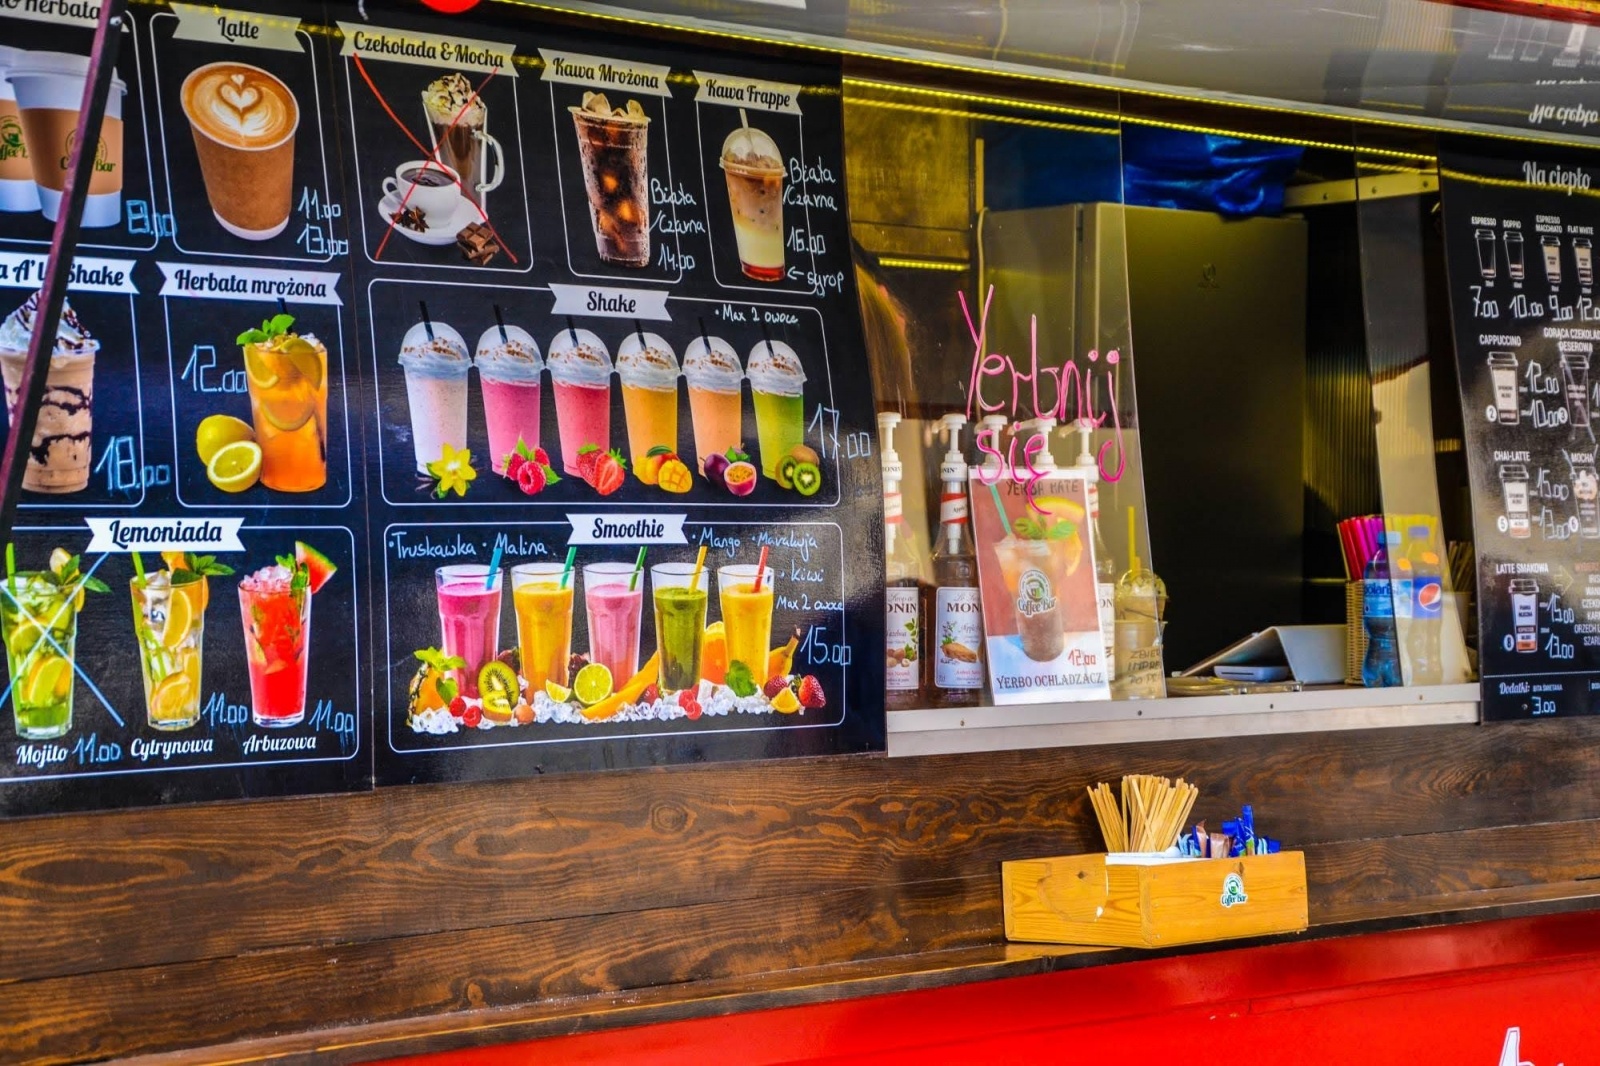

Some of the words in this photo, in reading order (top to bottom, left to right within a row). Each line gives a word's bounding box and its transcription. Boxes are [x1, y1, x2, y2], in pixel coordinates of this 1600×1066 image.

[218, 17, 260, 41] Latte
[353, 31, 437, 60] Czekolada
[553, 57, 595, 81] Kawa
[598, 63, 659, 89] Mrożona
[705, 79, 746, 102] Kawa
[746, 85, 791, 111] Frappe
[1522, 161, 1547, 186] Na
[298, 187, 342, 221] 11.00
[1471, 216, 1497, 226] ESPRESSO
[1503, 219, 1522, 229] DOPPIO
[1535, 214, 1561, 224] ESPRESSO
[786, 226, 827, 255] 16.00
[175, 269, 248, 293] Herbata
[251, 277, 327, 298] mrożona
[587, 290, 637, 314] Shake
[1469, 285, 1500, 318] 7.00
[1509, 294, 1544, 318] 10.00
[1479, 334, 1522, 347] CAPPUCCINO
[1525, 359, 1560, 394] 12.00
[808, 403, 871, 460] 17.00
[94, 436, 171, 490] 18.00
[1494, 450, 1531, 461] CHAI-LATTE
[1571, 453, 1594, 463] MOCHA
[109, 520, 222, 550] Lemoniada
[592, 518, 665, 539] Smoothie
[391, 531, 477, 559] Truskawka
[493, 532, 548, 557] Malina
[699, 527, 741, 558] Mango
[1496, 563, 1516, 574] LATTE
[801, 594, 812, 611] 2
[799, 624, 852, 665] 15.00
[1068, 649, 1097, 666] 12.00
[996, 675, 1033, 690] YERBO
[202, 692, 248, 726] 11.00
[1531, 696, 1557, 715] 3.00
[16, 744, 69, 768] Mojito
[71, 732, 121, 764] 11.00
[130, 737, 214, 761] Cytrynowa
[243, 734, 317, 755] Arbuzowa
